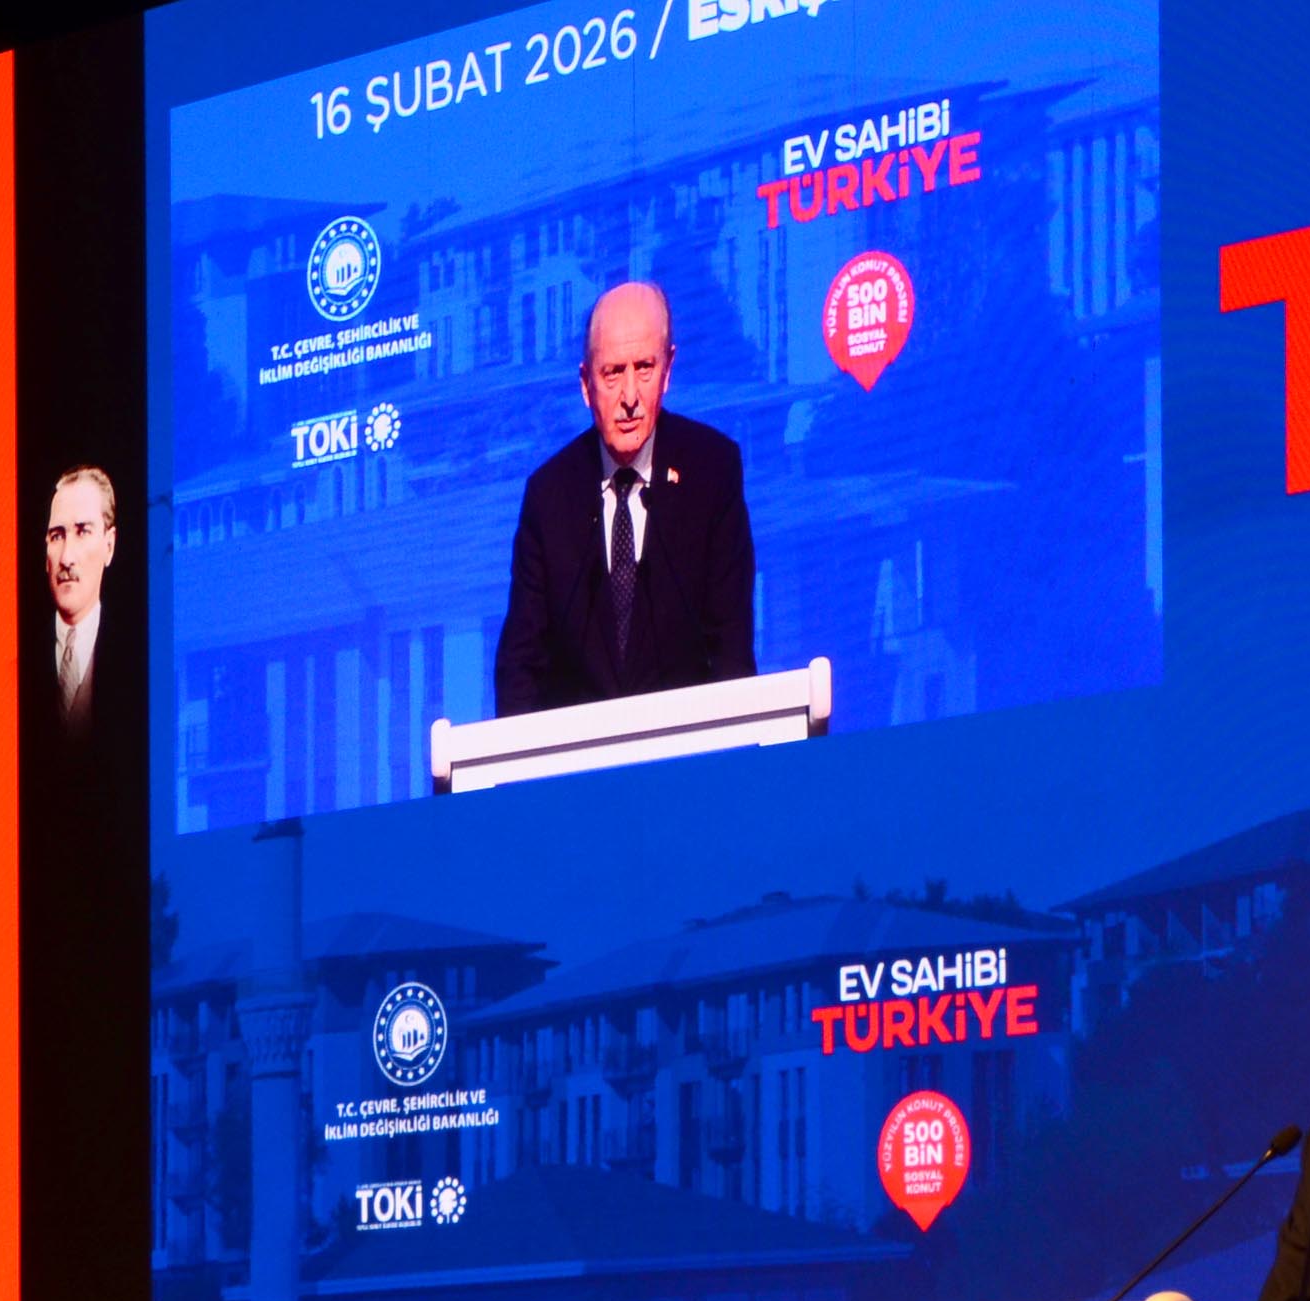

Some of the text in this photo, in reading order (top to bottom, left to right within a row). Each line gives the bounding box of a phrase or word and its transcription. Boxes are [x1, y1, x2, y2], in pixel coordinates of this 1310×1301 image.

[311, 86, 351, 139] 16
[365, 42, 512, 133] ŞUBAT
[525, 9, 637, 86] 2026
[784, 130, 829, 175] EV
[847, 278, 888, 307] 500
[271, 345, 293, 361] T.C.
[403, 313, 419, 331] VE
[840, 962, 884, 1001] EV
[337, 1103, 358, 1118] T.C.
[360, 1098, 401, 1119] ÇEVRE,
[470, 1089, 486, 1105] VE
[325, 1121, 358, 1140] İKLİM
[903, 1119, 944, 1143] 500
[906, 1182, 942, 1195] KONUT
